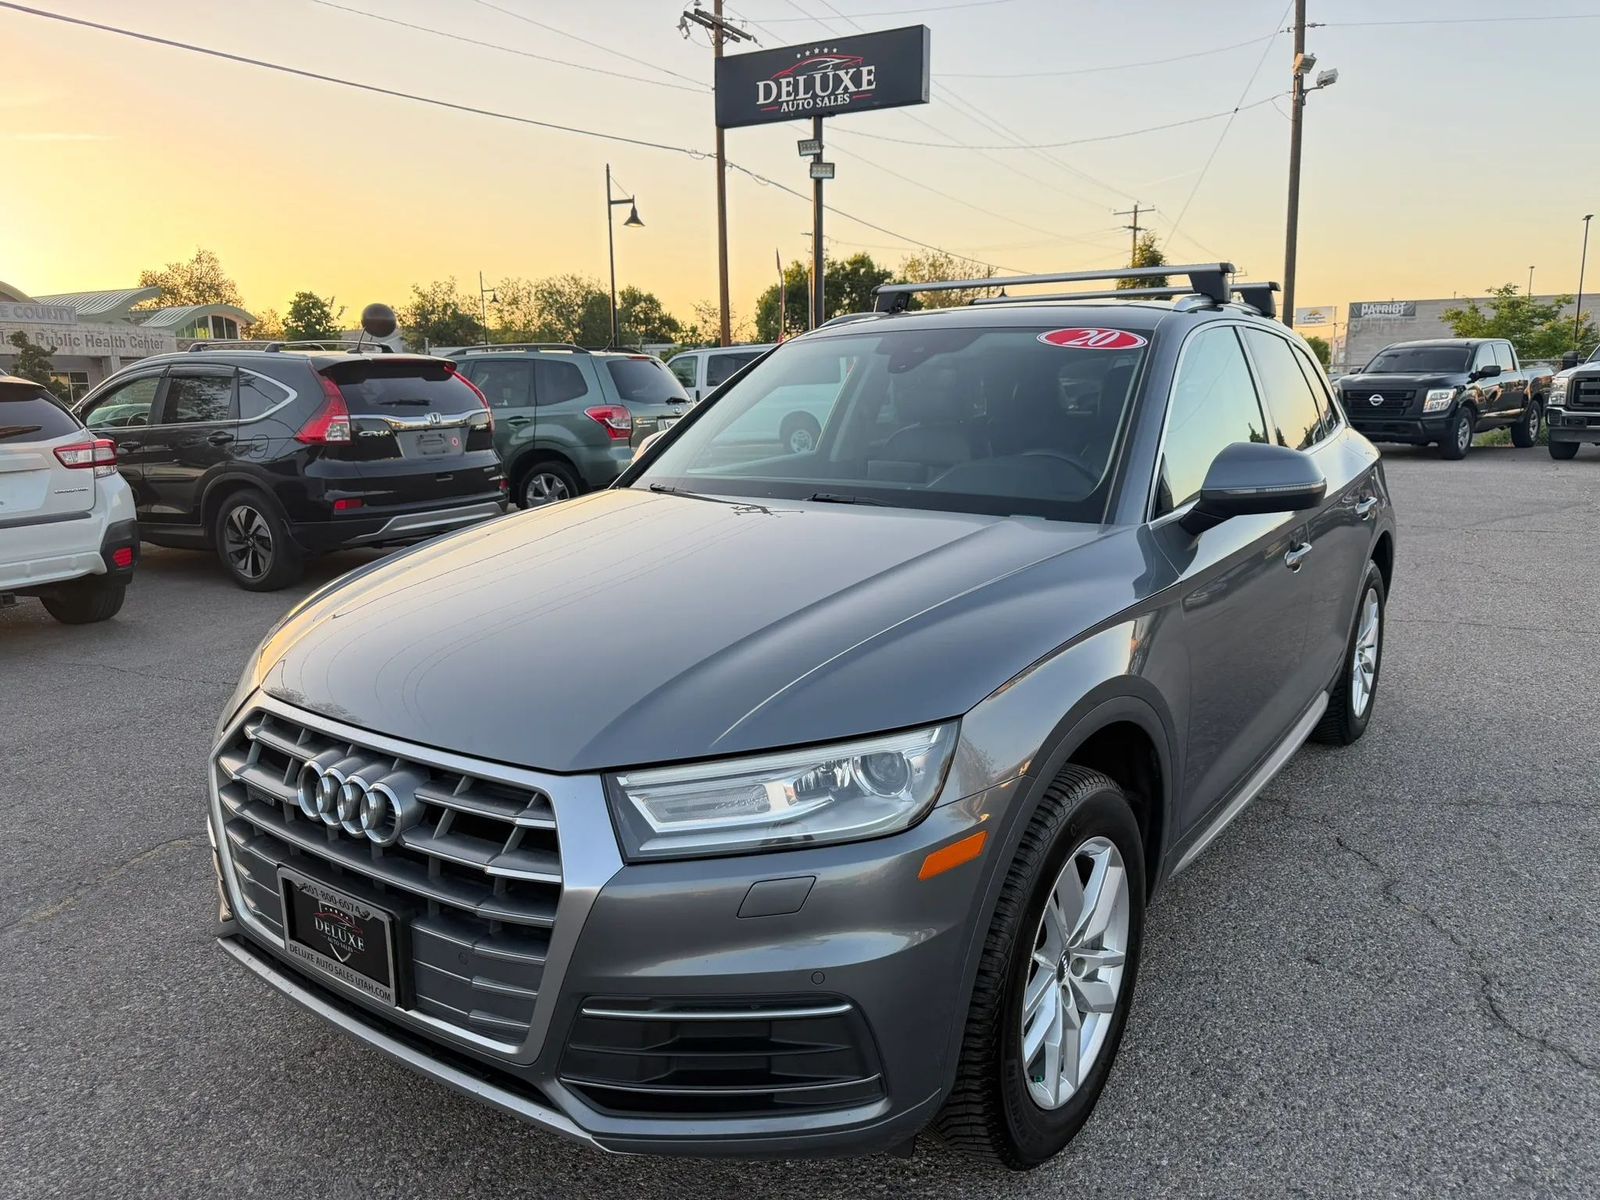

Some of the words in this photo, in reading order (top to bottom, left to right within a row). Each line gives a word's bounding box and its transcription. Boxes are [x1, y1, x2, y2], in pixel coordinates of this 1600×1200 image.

[756, 65, 876, 105] DELUXE
[781, 99, 813, 112] AUTO
[816, 93, 850, 108] SALES
[13, 305, 72, 320] COUNTY
[1361, 302, 1406, 316] PATRIOT
[35, 332, 81, 347] Public
[85, 334, 126, 348] Health
[129, 335, 163, 350] Center
[1062, 330, 1120, 346] 20
[315, 917, 365, 952] DELUXE
[289, 943, 314, 962] DELUXE
[316, 957, 334, 972] AUTO
[334, 966, 354, 983] SALES
[355, 978, 392, 1003] UTAH.COM
